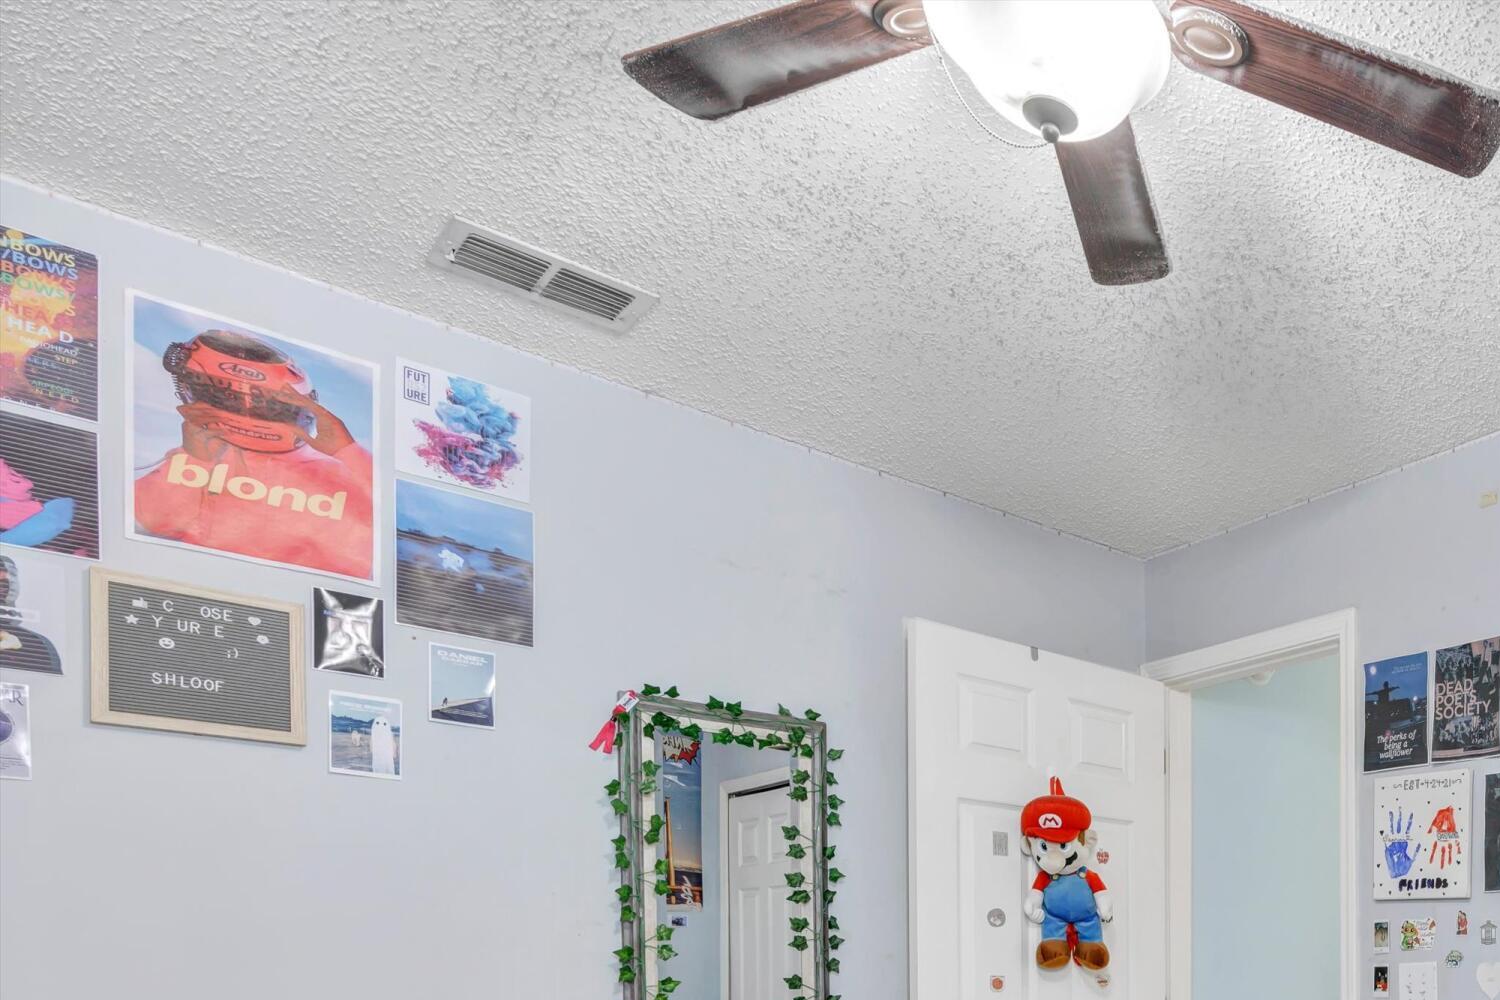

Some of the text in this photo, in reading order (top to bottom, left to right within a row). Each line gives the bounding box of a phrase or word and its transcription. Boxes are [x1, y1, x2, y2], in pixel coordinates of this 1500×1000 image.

[407, 369, 427, 384] FUT
[407, 388, 427, 403] URE
[166, 453, 347, 521] blond
[200, 606, 233, 622] OSE
[177, 619, 200, 634] UR
[151, 672, 224, 692] SHLOOF
[1435, 678, 1474, 696] DEAD
[1435, 689, 1477, 708] POETS
[1435, 699, 1492, 721] SOCIETY
[1384, 740, 1402, 751] being
[1043, 816, 1059, 826] M
[1399, 877, 1449, 892] FRIENDS
